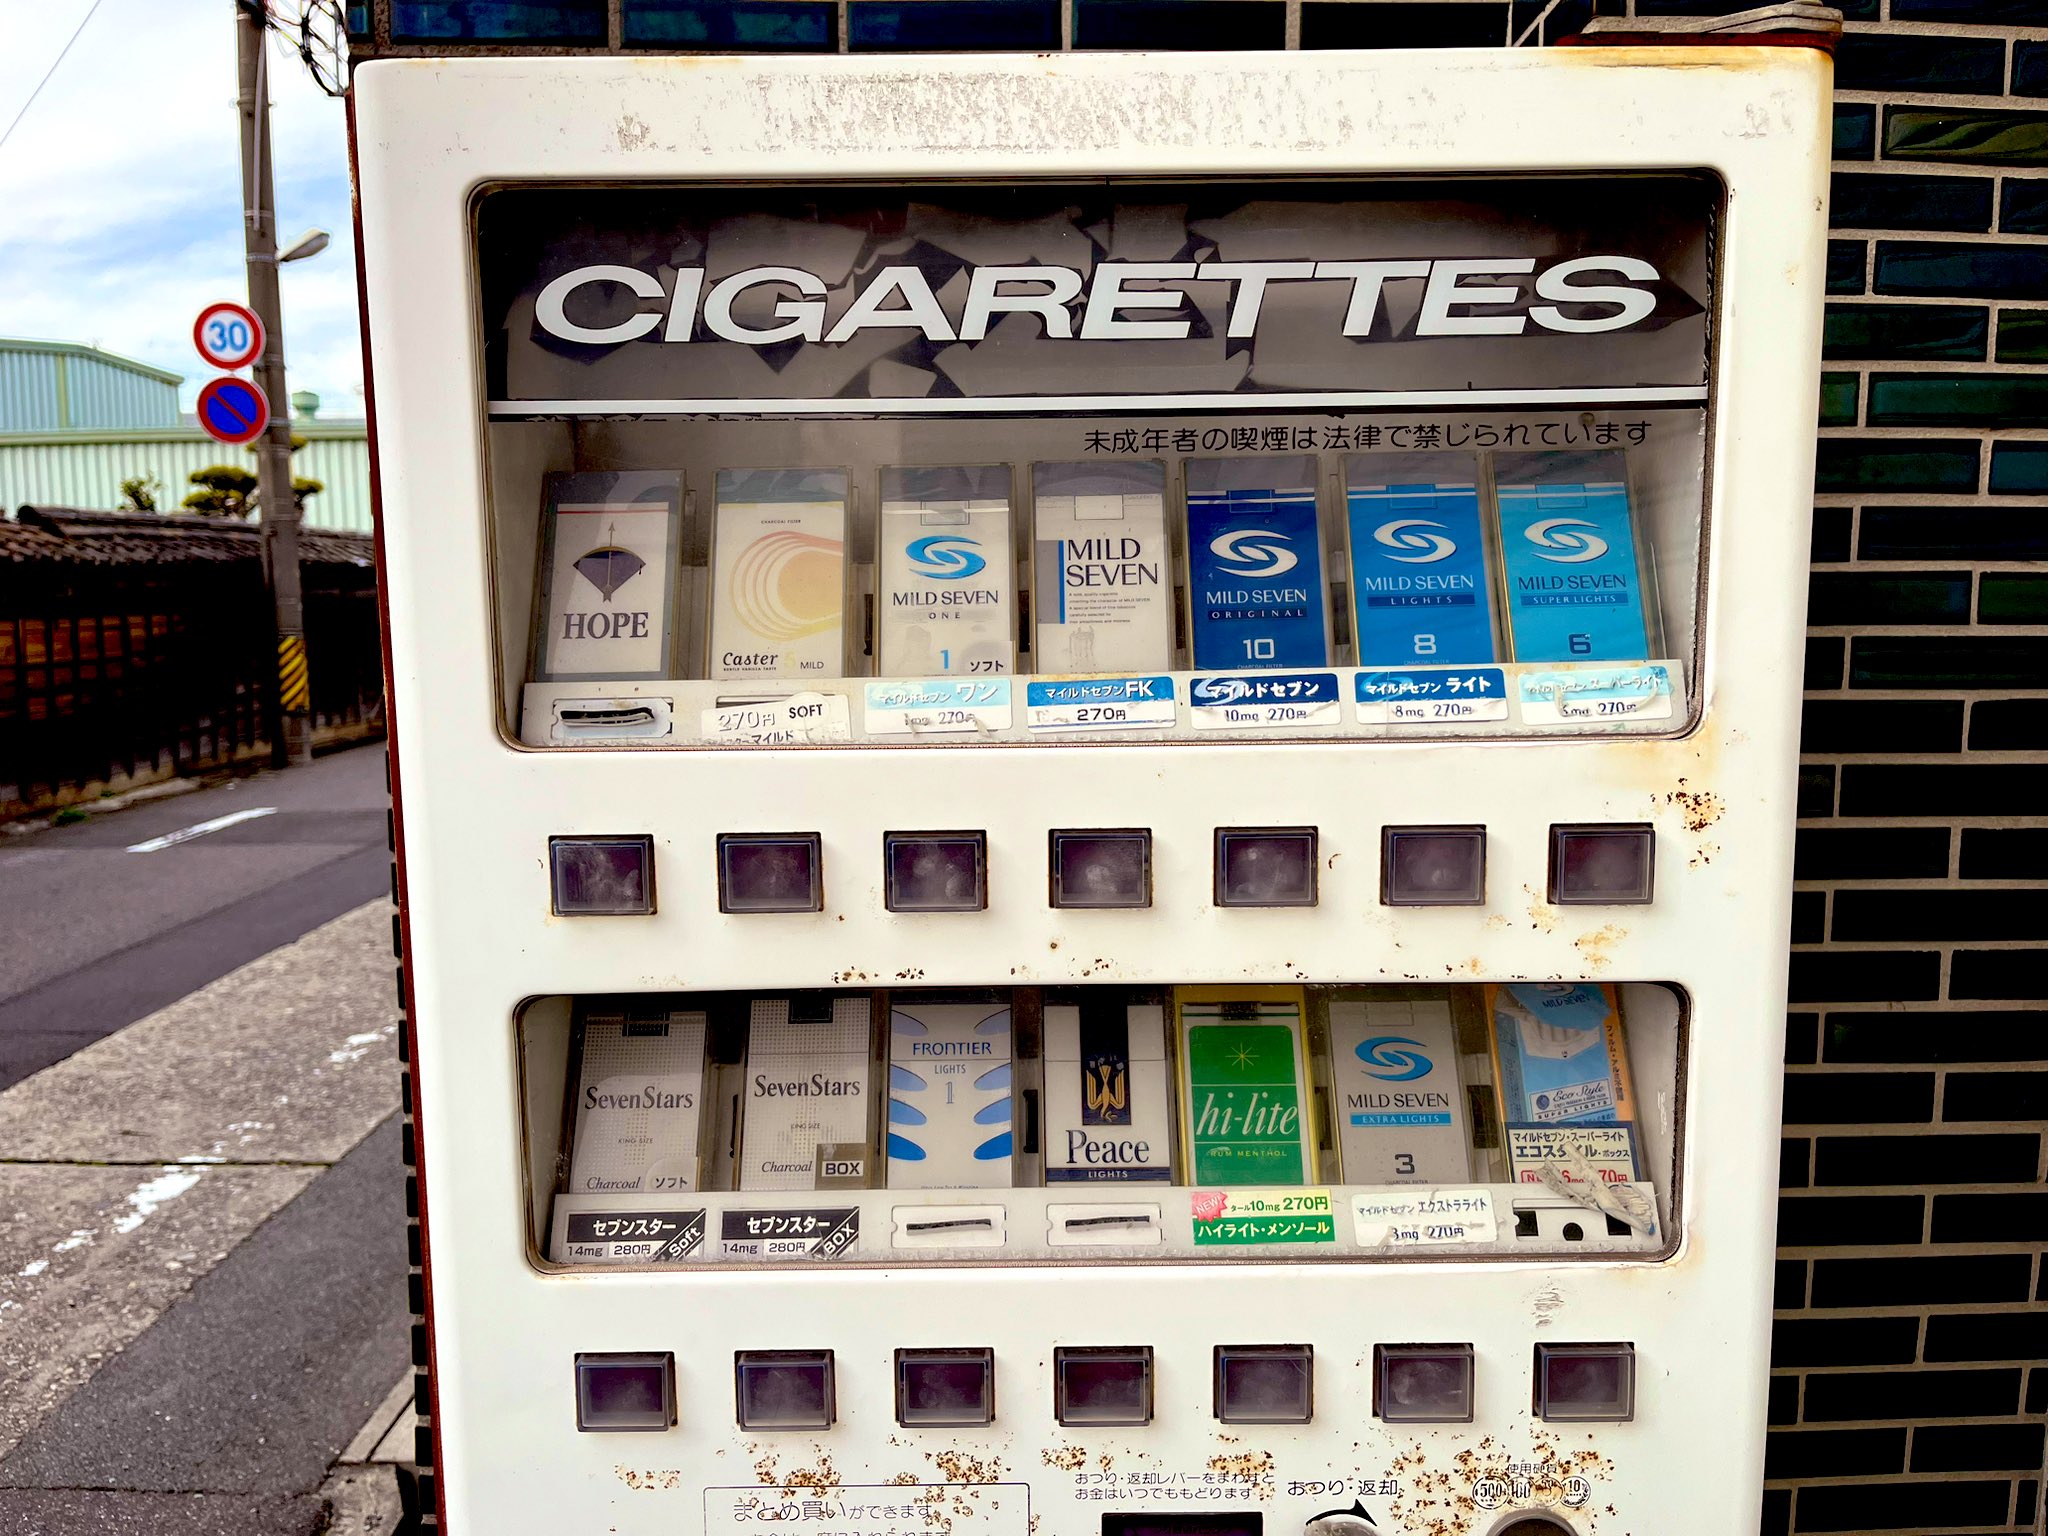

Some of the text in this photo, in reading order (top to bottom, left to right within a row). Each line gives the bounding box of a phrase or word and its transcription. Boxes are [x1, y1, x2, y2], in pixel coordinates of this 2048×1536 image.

[534, 255, 1661, 346] CIGARETTES
[208, 320, 249, 353] 30
[1083, 419, 1653, 454] 未成年者の喫煙は法律で禁じられています
[1067, 537, 1141, 561] MILD
[1065, 563, 1159, 588] SEVEN
[1366, 574, 1474, 591] MILD SEVEN
[1518, 574, 1627, 591] MILD SEVEN
[893, 589, 999, 607] MILD SEVEN
[1206, 588, 1307, 605] MILD SEVEN
[1390, 596, 1454, 606] LIGHTS
[1533, 594, 1617, 604] SUPER LIGHTS
[928, 611, 961, 620] ONE
[1211, 608, 1304, 619] ORIGINAL
[562, 612, 650, 640] HOPE
[1242, 638, 1275, 660] 10
[1413, 633, 1437, 655] 8
[1568, 633, 1592, 655] 6
[722, 651, 779, 666] Caster
[800, 661, 825, 670] MILD
[940, 649, 950, 670] 1
[969, 660, 1005, 673] ソフト
[956, 683, 999, 703] ワン
[1207, 680, 1320, 699] マイルドセブン
[1366, 676, 1492, 696] マイルドセブン ライト
[788, 704, 823, 719] SOFT
[1077, 708, 1126, 721] 270円
[1267, 707, 1307, 722] 270円
[1395, 703, 1473, 718] 8mg 270円
[912, 1041, 993, 1056] FRONTIER
[934, 1064, 967, 1075] LIGHTS
[945, 1081, 955, 1105] 1
[1347, 1092, 1449, 1109] MILD SEVEN
[1552, 1089, 1576, 1102] Eco
[1576, 1082, 1604, 1097] Style
[1195, 1091, 1299, 1136] hi-lite
[1362, 1114, 1440, 1124] EXTRA LIGHTS
[1513, 1131, 1625, 1143] マイルドセブン・スーパーライト
[1065, 1129, 1150, 1164] Peace
[1237, 1149, 1288, 1158] MENTHOL
[761, 1161, 812, 1173] Charcoal
[825, 1162, 860, 1176] BOX
[1394, 1153, 1416, 1175] 3
[586, 1176, 641, 1190] Charcoal
[655, 1176, 689, 1189] ソフト
[1088, 1170, 1129, 1179] LIGHTS
[1283, 1196, 1329, 1211] 270円
[593, 1218, 677, 1237] セブンスター
[747, 1216, 831, 1234] セブンスター
[1198, 1221, 1331, 1238] ハイライト・メンソール
[668, 1226, 701, 1257] Soft
[823, 1222, 855, 1255] BOX
[568, 1244, 651, 1257] 14mg 280円
[723, 1242, 806, 1255] 14mg 280円
[1074, 1471, 1276, 1485] おつり・返却レバーをまわすと
[1074, 1486, 1254, 1500] お金はいつでももどります
[1287, 1479, 1399, 1496] おつり・返却
[1480, 1482, 1503, 1498] 500
[733, 1500, 934, 1522] まとめ買いができます
